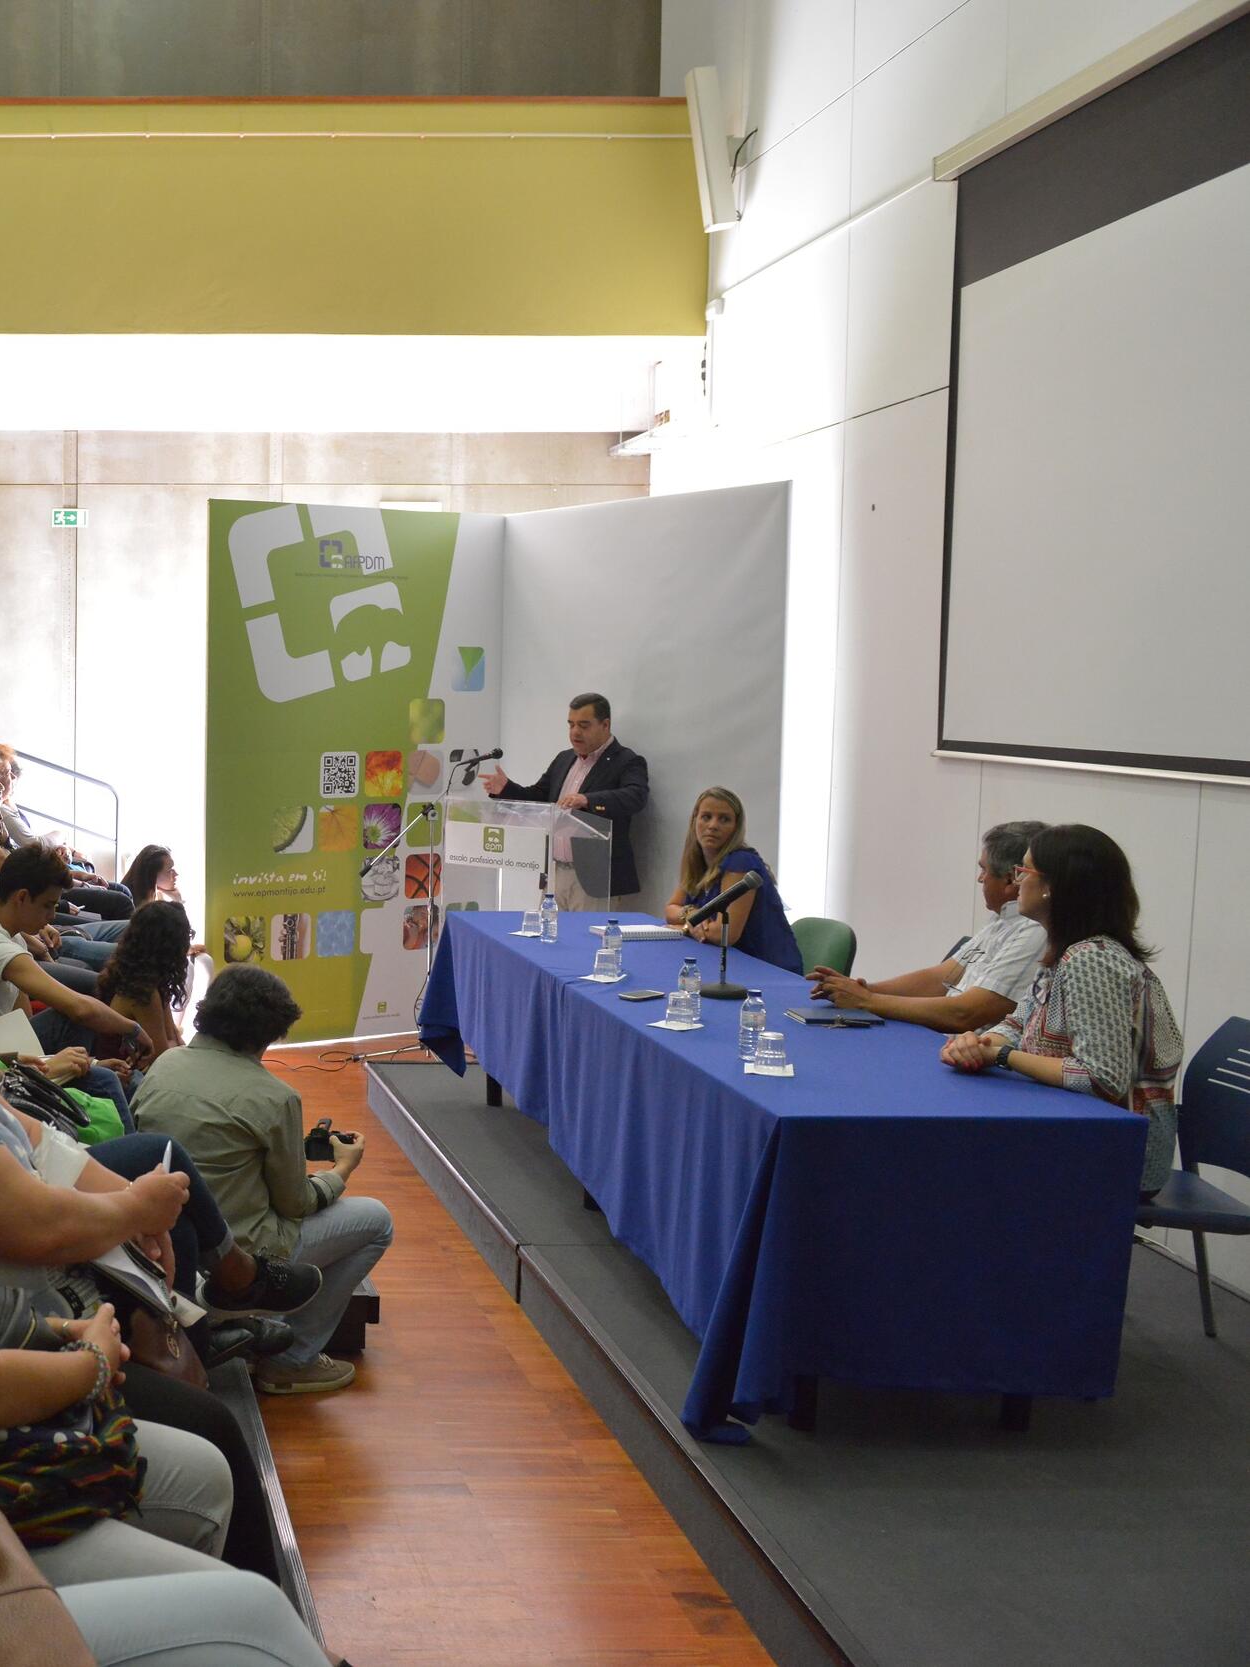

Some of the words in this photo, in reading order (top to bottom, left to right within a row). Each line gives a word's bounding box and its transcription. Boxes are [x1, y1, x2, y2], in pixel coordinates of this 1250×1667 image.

[449, 854, 468, 862] escola
[470, 855, 503, 866] profissional
[516, 860, 540, 871] montijo
[233, 872, 284, 885] invista
[289, 873, 307, 882] em
[313, 869, 327, 882] si!
[233, 886, 326, 898] www.epmontijo.edu.pt
